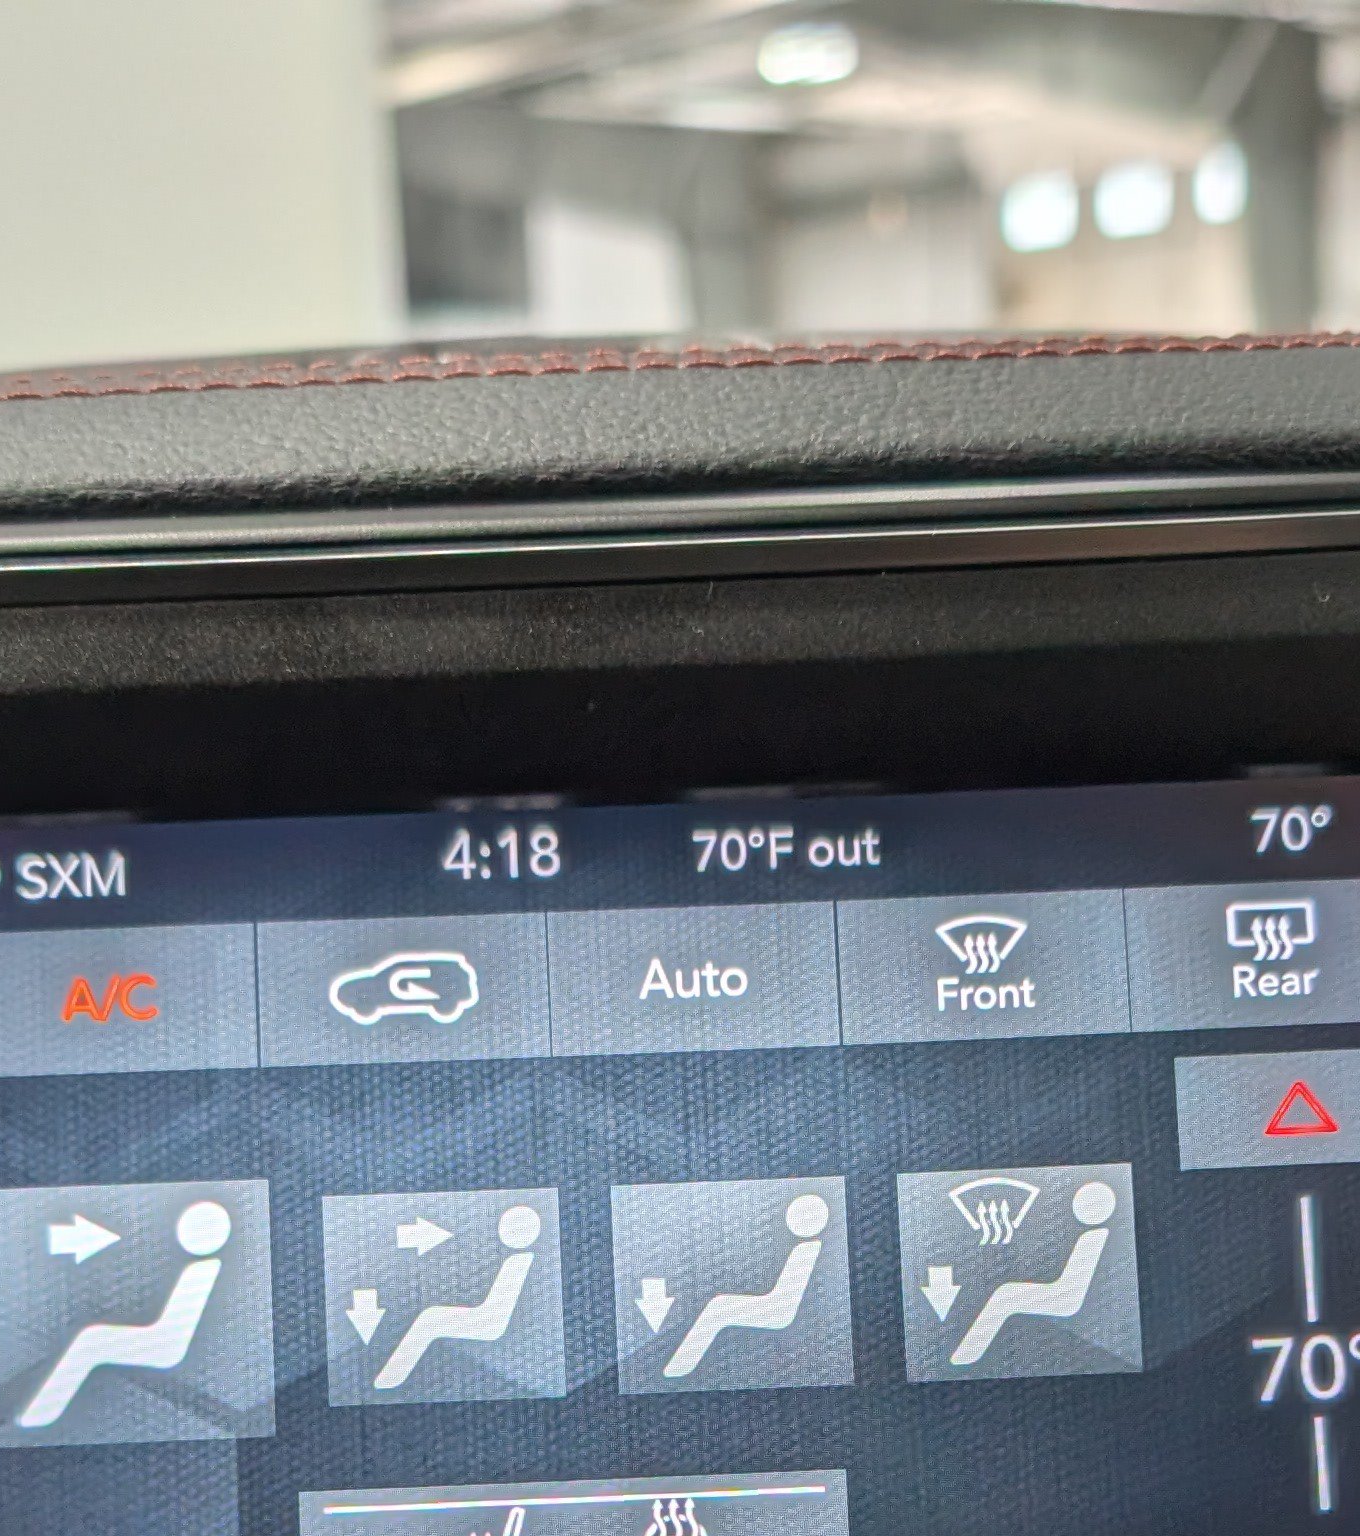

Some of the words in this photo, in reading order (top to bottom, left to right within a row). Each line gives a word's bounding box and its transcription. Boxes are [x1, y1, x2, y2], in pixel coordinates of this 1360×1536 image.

[692, 829, 794, 872] 70°F
[808, 829, 881, 869] out
[1252, 805, 1332, 855] 70°
[15, 851, 127, 900] SXM
[443, 829, 562, 880] 4:18
[61, 974, 158, 1022] A/C
[639, 959, 747, 1001] Auto
[937, 975, 1035, 1012] Front
[1232, 964, 1320, 999] Rear
